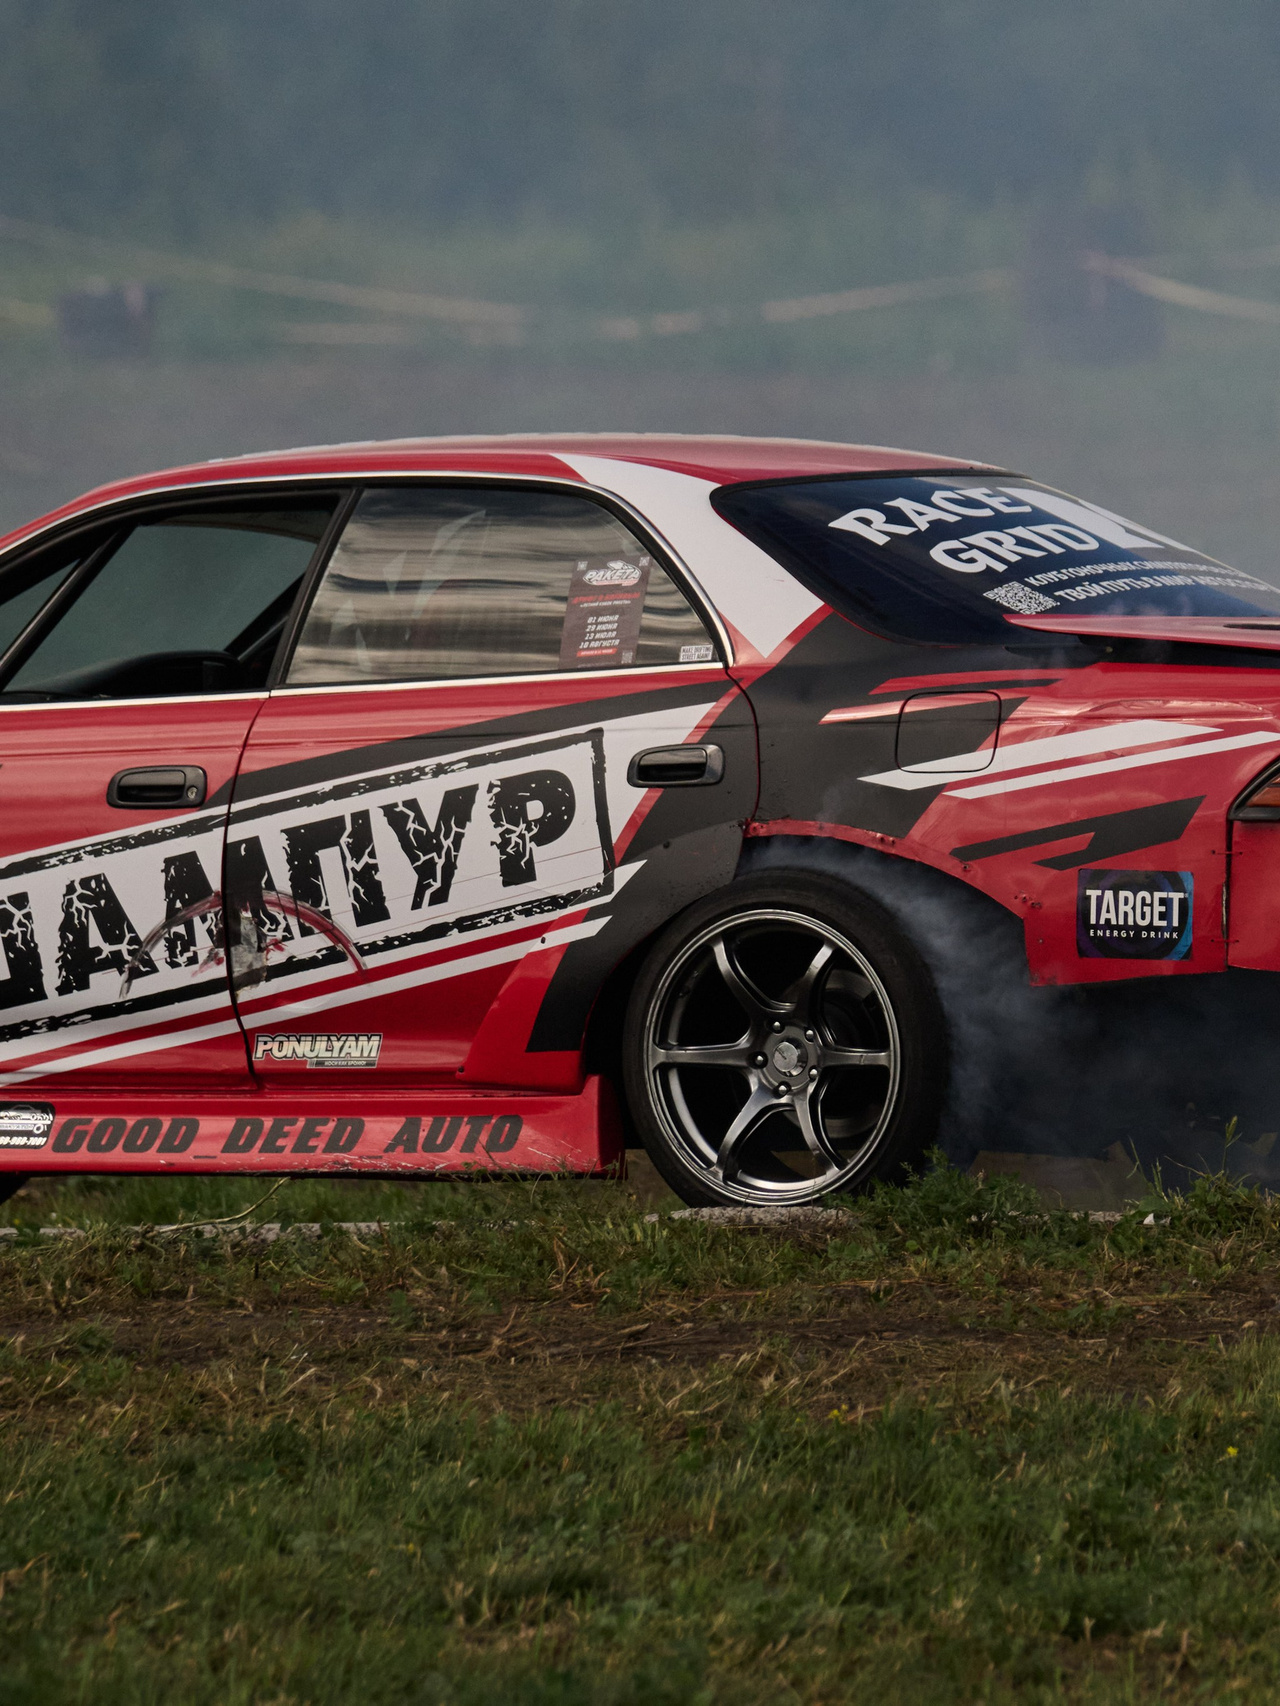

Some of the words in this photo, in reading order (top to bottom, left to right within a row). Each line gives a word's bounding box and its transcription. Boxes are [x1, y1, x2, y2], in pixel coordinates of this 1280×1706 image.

[828, 487, 1032, 546] RACE
[929, 523, 1100, 573] GRID
[585, 568, 640, 581] РАКЕТА
[1024, 570, 1069, 587] КЛУБ
[1063, 560, 1134, 579] ГОНОЧНЫХ
[1054, 581, 1105, 601] ТВОЙ
[1099, 576, 1151, 594] ПУТЬ
[1151, 575, 1163, 587] В
[1086, 889, 1184, 927] TARGET
[1089, 929, 1134, 938] ENERGY
[1141, 931, 1179, 939] DRINK
[254, 1034, 381, 1059] PONULYAM
